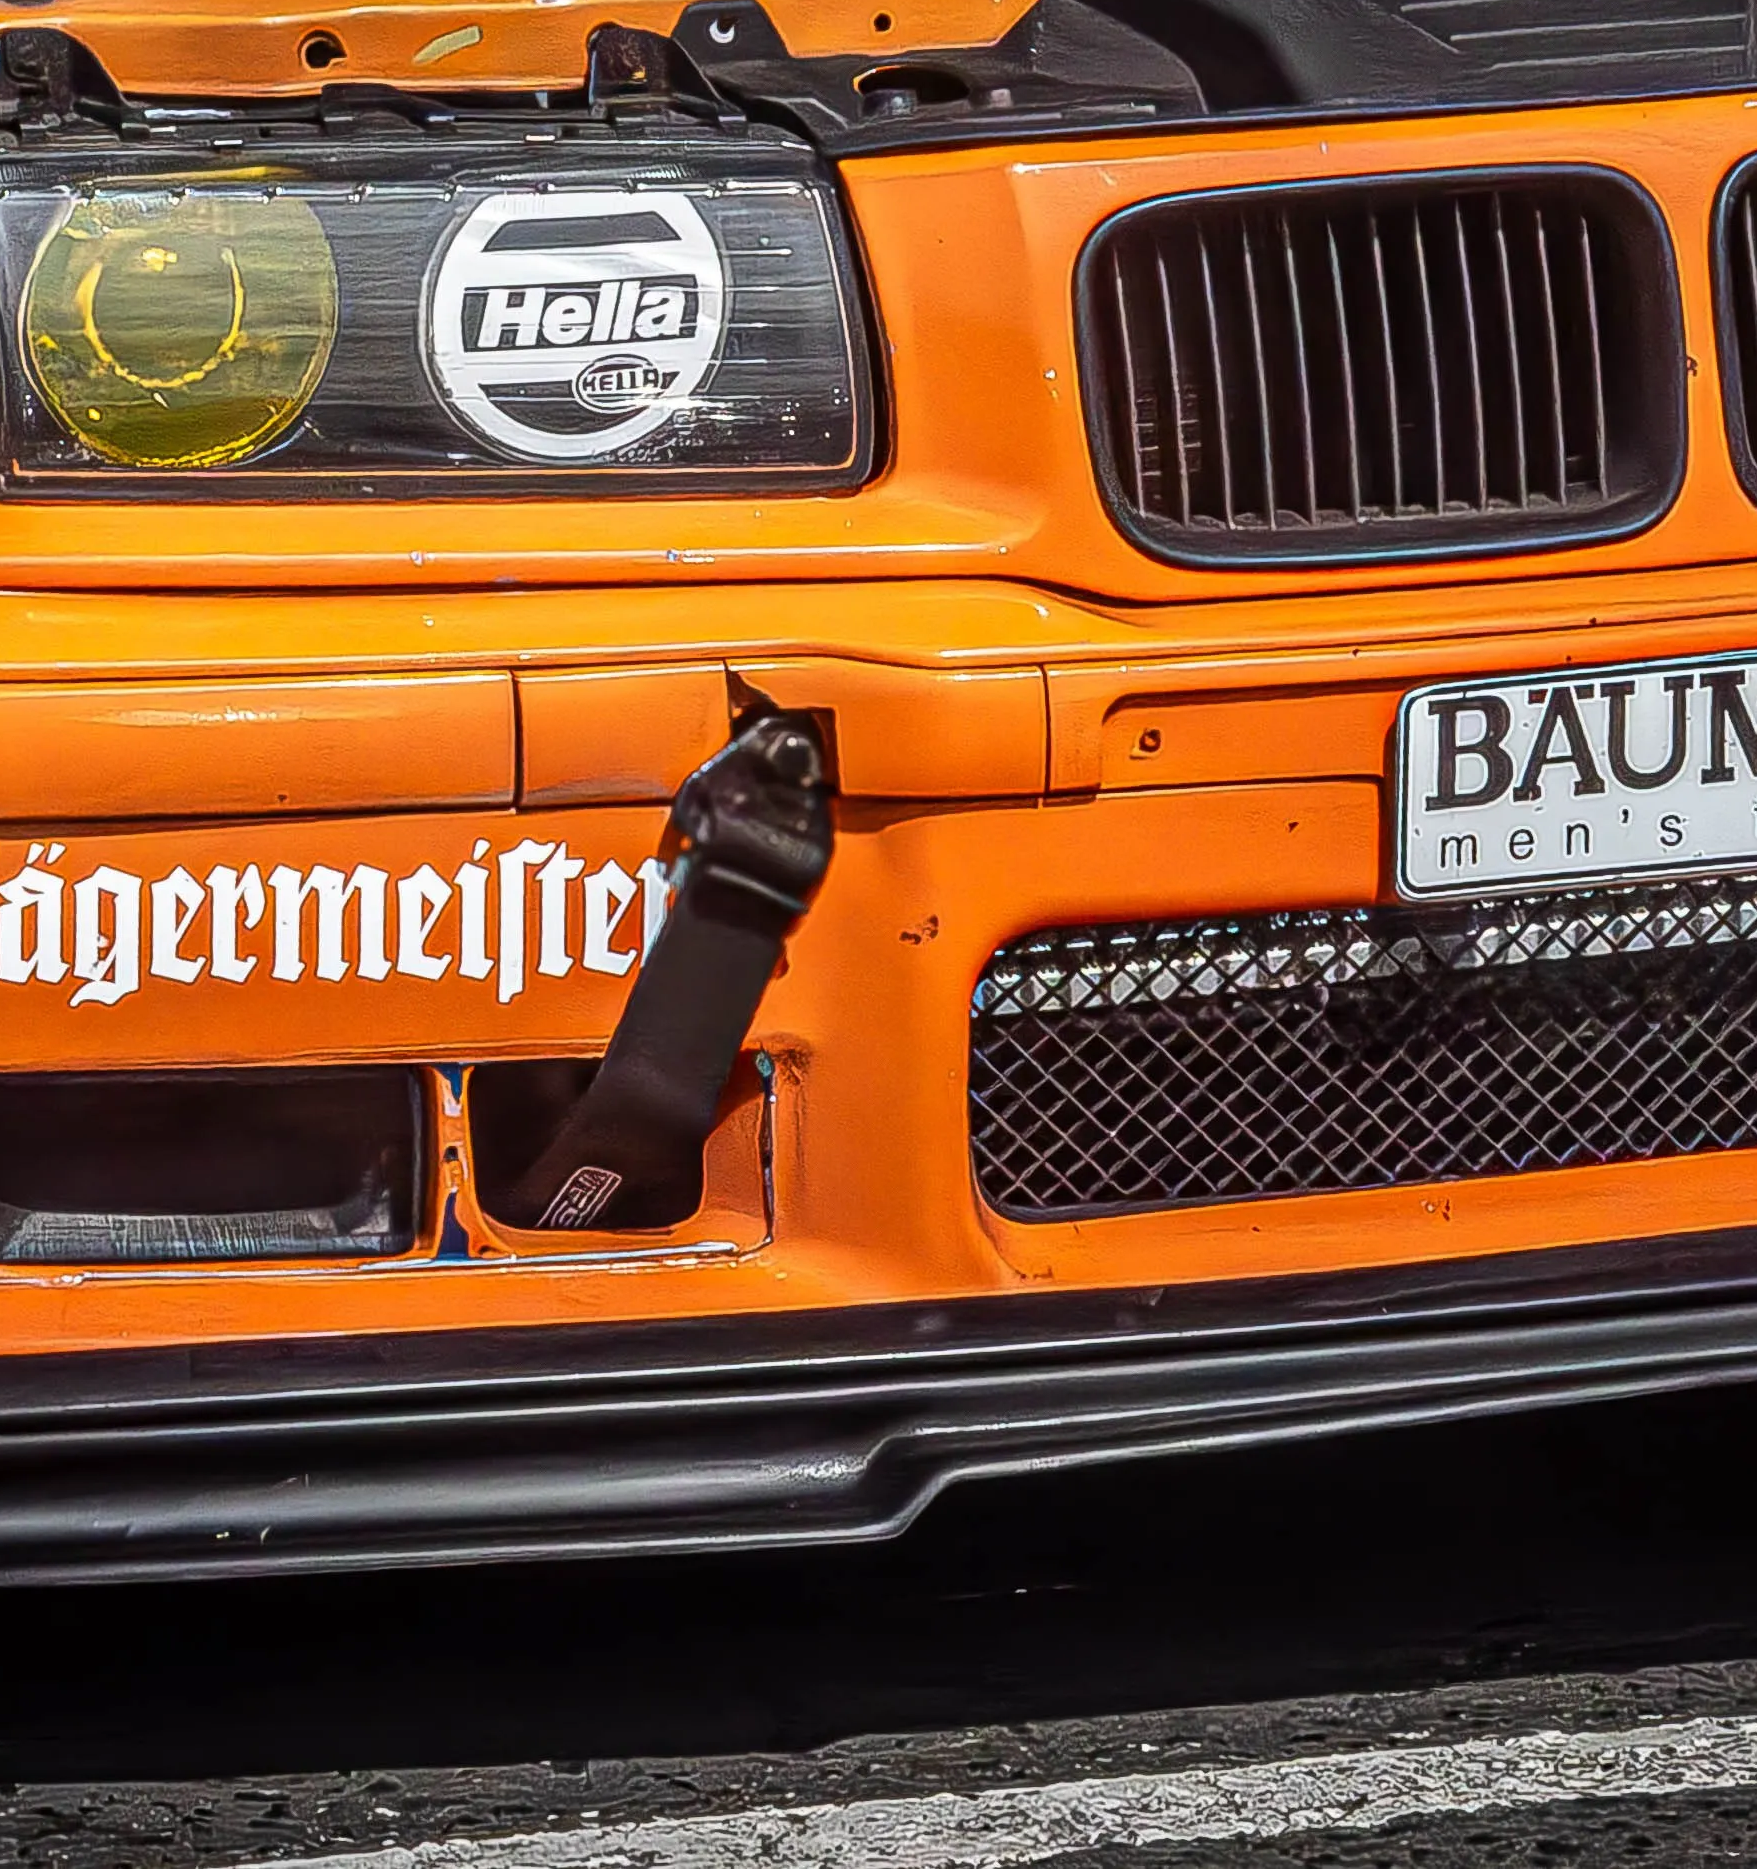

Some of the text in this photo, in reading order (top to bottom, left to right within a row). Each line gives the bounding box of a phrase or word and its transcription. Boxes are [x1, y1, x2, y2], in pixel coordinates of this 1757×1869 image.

[477, 279, 686, 349] Hella
[580, 367, 662, 396] HELLA
[1440, 806, 1685, 868] men's
